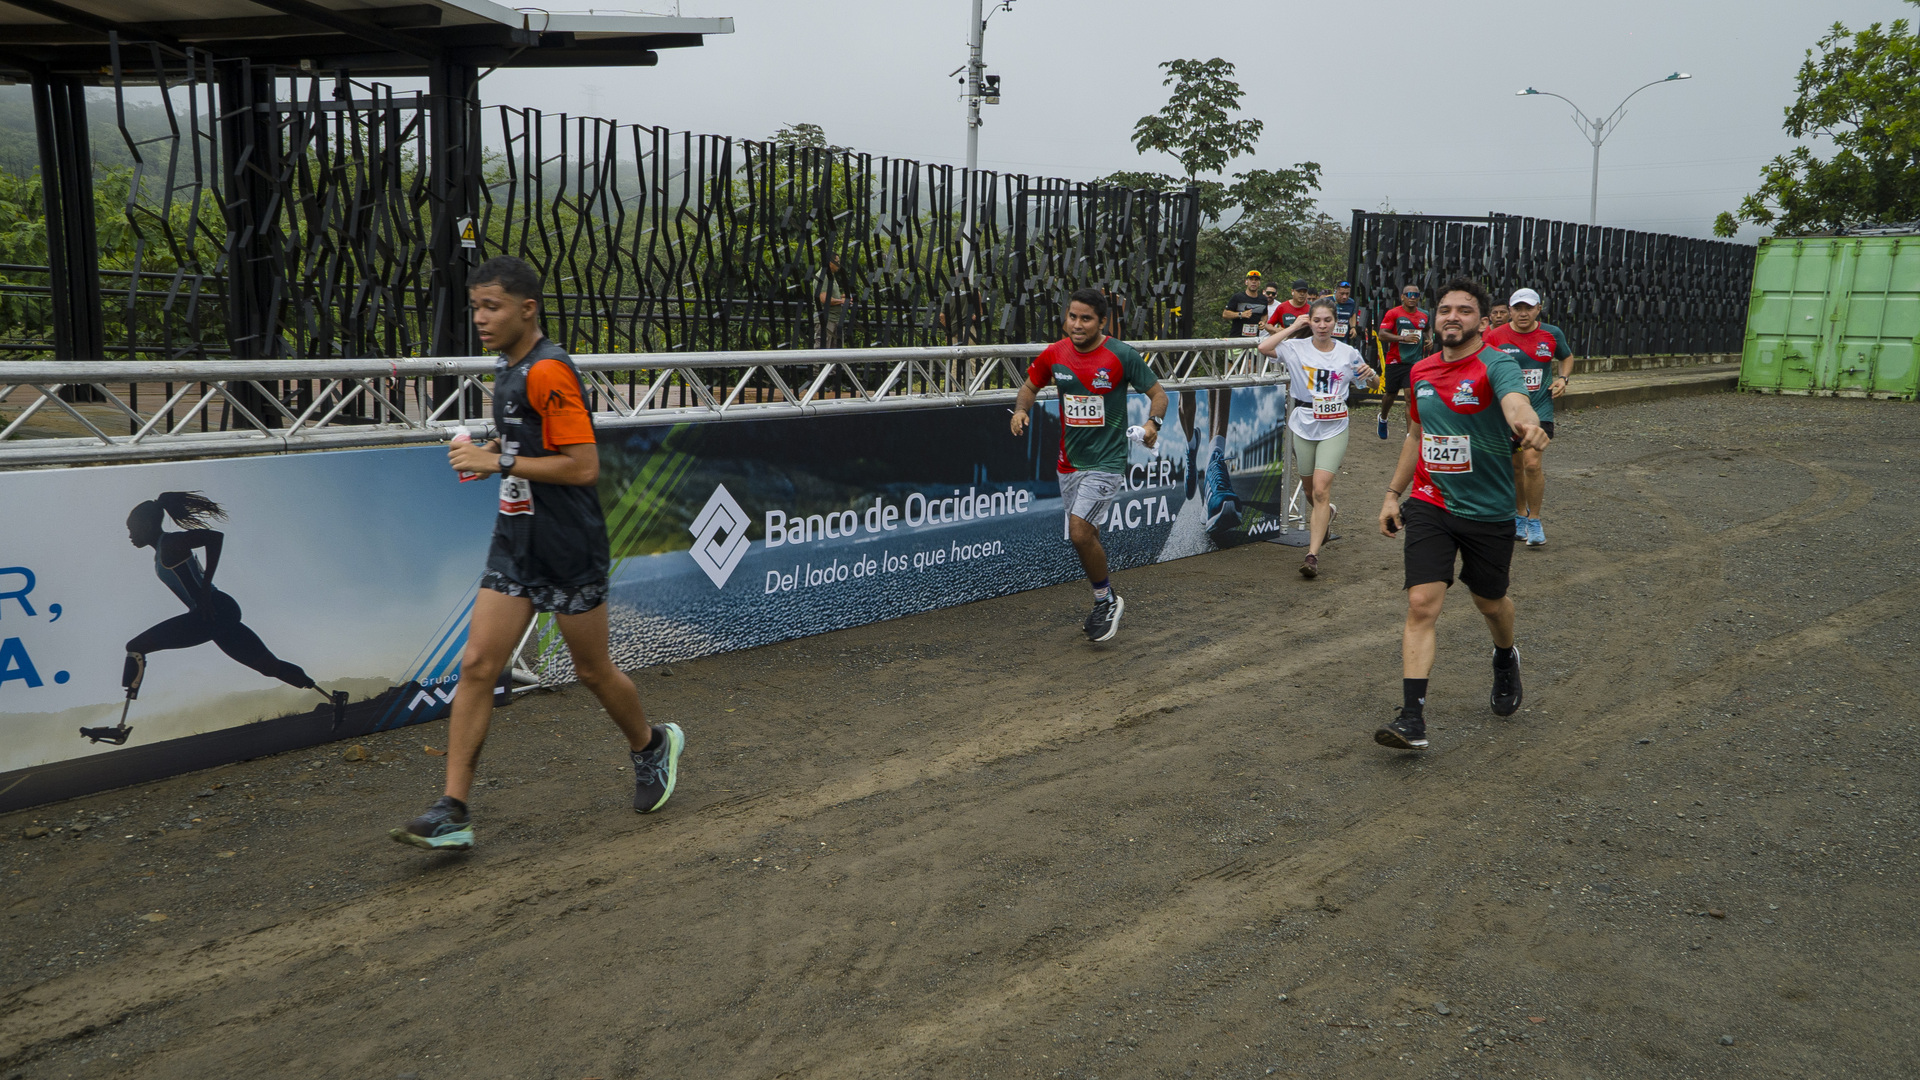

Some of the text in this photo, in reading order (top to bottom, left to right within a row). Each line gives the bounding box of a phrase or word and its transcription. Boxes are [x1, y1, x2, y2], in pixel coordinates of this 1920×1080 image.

[1524, 376, 1537, 384] 61
[1068, 404, 1096, 417] 2118
[1318, 402, 1343, 413] 1887
[1427, 446, 1459, 461] 1247
[765, 486, 1029, 548] Banco de Occidente
[1248, 519, 1280, 536] AVAL
[765, 540, 1005, 595] Del lado de los que hacen.
[420, 673, 459, 688] Grupo
